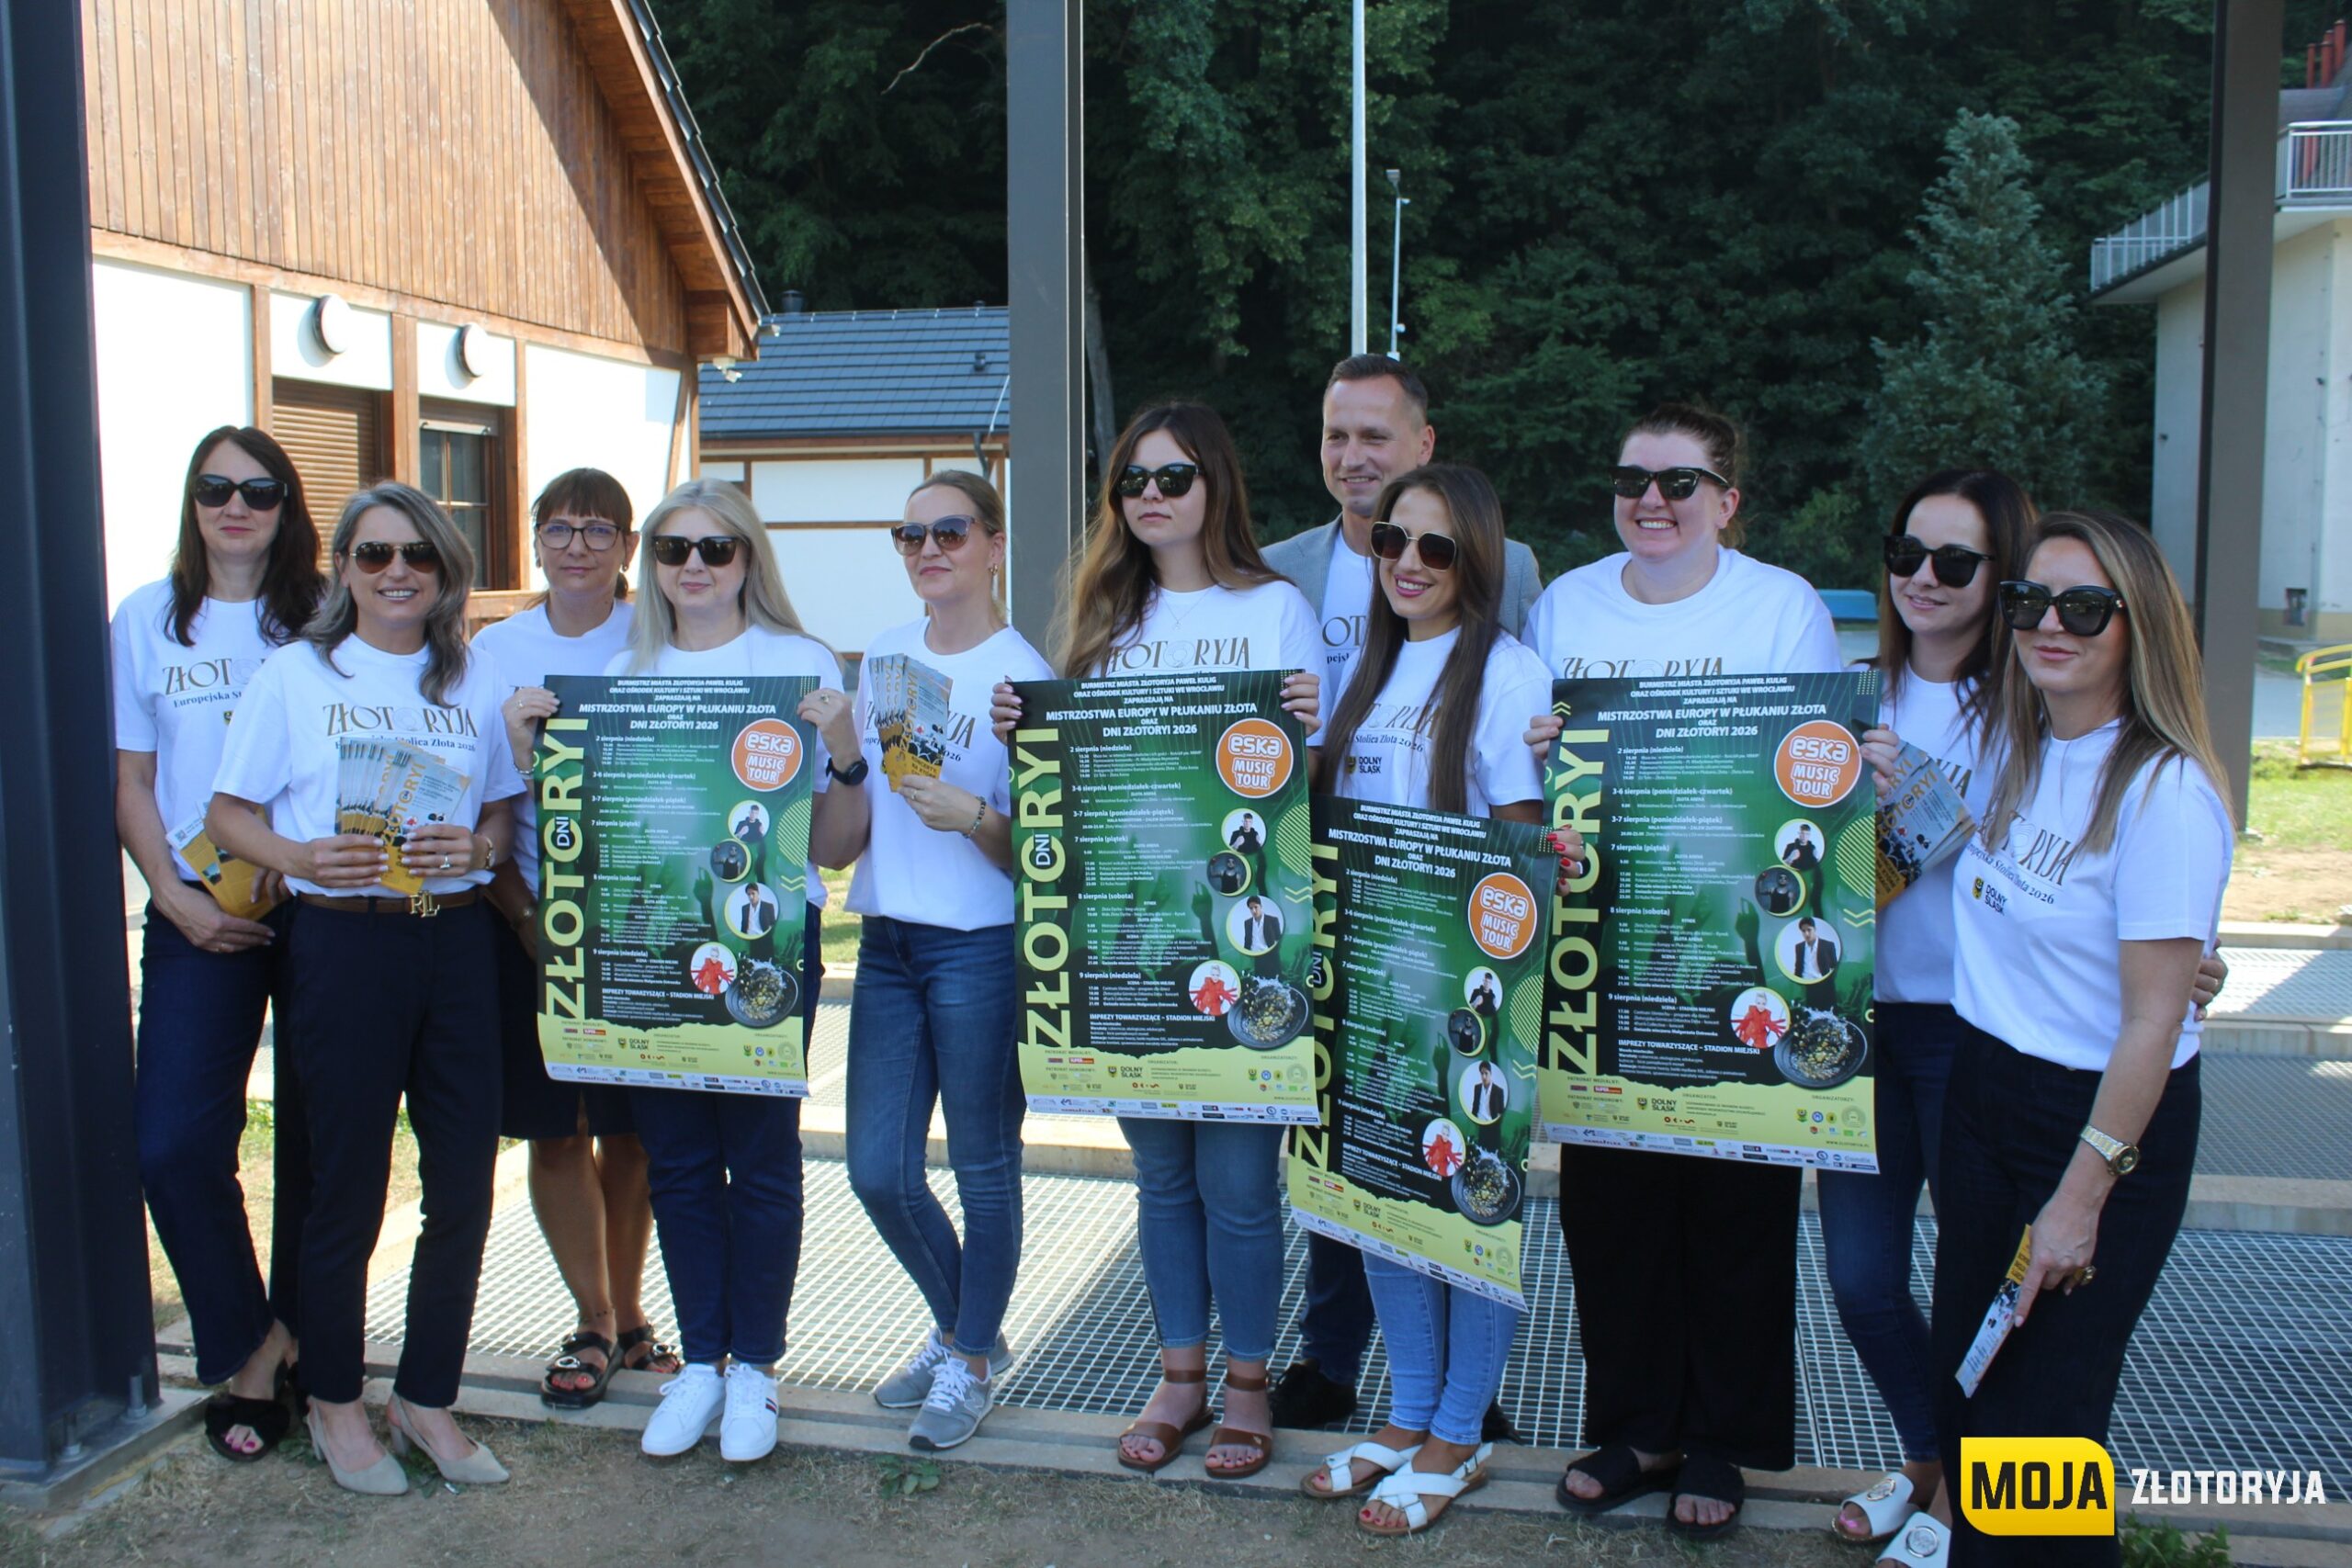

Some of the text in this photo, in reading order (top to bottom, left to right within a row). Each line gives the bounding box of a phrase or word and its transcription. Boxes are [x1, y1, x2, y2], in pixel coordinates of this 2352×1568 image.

[1108, 637, 1250, 672] ŁOTORYJA
[173, 691, 231, 708] Europejska
[579, 704, 775, 714] MISTRZOSTWA EUROPY W PŁUKANIU ZŁOTA
[1045, 703, 1258, 721] MISTRZOSTWA EUROPY W PŁUKANIU ZŁOTA
[1598, 705, 1826, 721] MISTRZOSTWA EUROPY W PŁUKANIU ZŁOTA
[322, 702, 479, 738] ZŁOTORYJA
[630, 720, 718, 729] DNI ZŁOTORYI 2026
[1102, 725, 1197, 737] DNI ZŁOTORYI 2026
[1656, 727, 1758, 738] DNI ZŁOTORYI 2026
[430, 738, 456, 748] Złota
[747, 732, 793, 755] eska
[1075, 745, 1100, 753] sierpnia
[1100, 744, 1132, 752] (niedziela)
[1229, 735, 1282, 757] eska
[1354, 734, 1423, 752] Stolica Złota 2026
[1650, 746, 1683, 754] (niedziela)
[1792, 737, 1848, 763] eska
[747, 755, 785, 771] MUSIC
[942, 750, 962, 761] 026
[1359, 756, 1382, 765] DOLNY
[748, 767, 777, 782] TOUR
[1233, 760, 1274, 774] MUSIC
[1360, 763, 1381, 774] ŚLĄSK
[1793, 764, 1838, 782] MUSIC
[1236, 773, 1269, 787] TOUR
[1795, 780, 1830, 795] TOUR
[557, 817, 570, 847] DNI
[1035, 834, 1050, 866] DNI
[1329, 829, 1511, 868] MISTRZOSTWA EUROPY W PŁUKANIU ZŁOTA
[1611, 843, 1615, 852] 7
[1617, 843, 1643, 852] sierpnia
[543, 718, 589, 1020] ZŁOTORYI
[1375, 856, 1455, 878] DNI ZŁOTORYI 2026
[1016, 728, 1071, 1048] ZŁOTORYI
[1985, 884, 2007, 906] DOLNY
[2028, 886, 2055, 905] 2026
[1482, 886, 1527, 920] eska
[1616, 907, 1641, 915] sierpnia
[1643, 908, 1670, 916] (sobota)
[1483, 913, 1518, 937] MUSIC
[1483, 928, 1511, 950] TOUR
[1609, 993, 1677, 1004] 9 sierpnia (niedziela)
[1618, 1039, 1759, 1055] IMPREZY TOWARZYSZĄCE STADION MIEJSKI
[1652, 1098, 1677, 1106] DOLNY
[1652, 1104, 1676, 1112] ŚLĄSK
